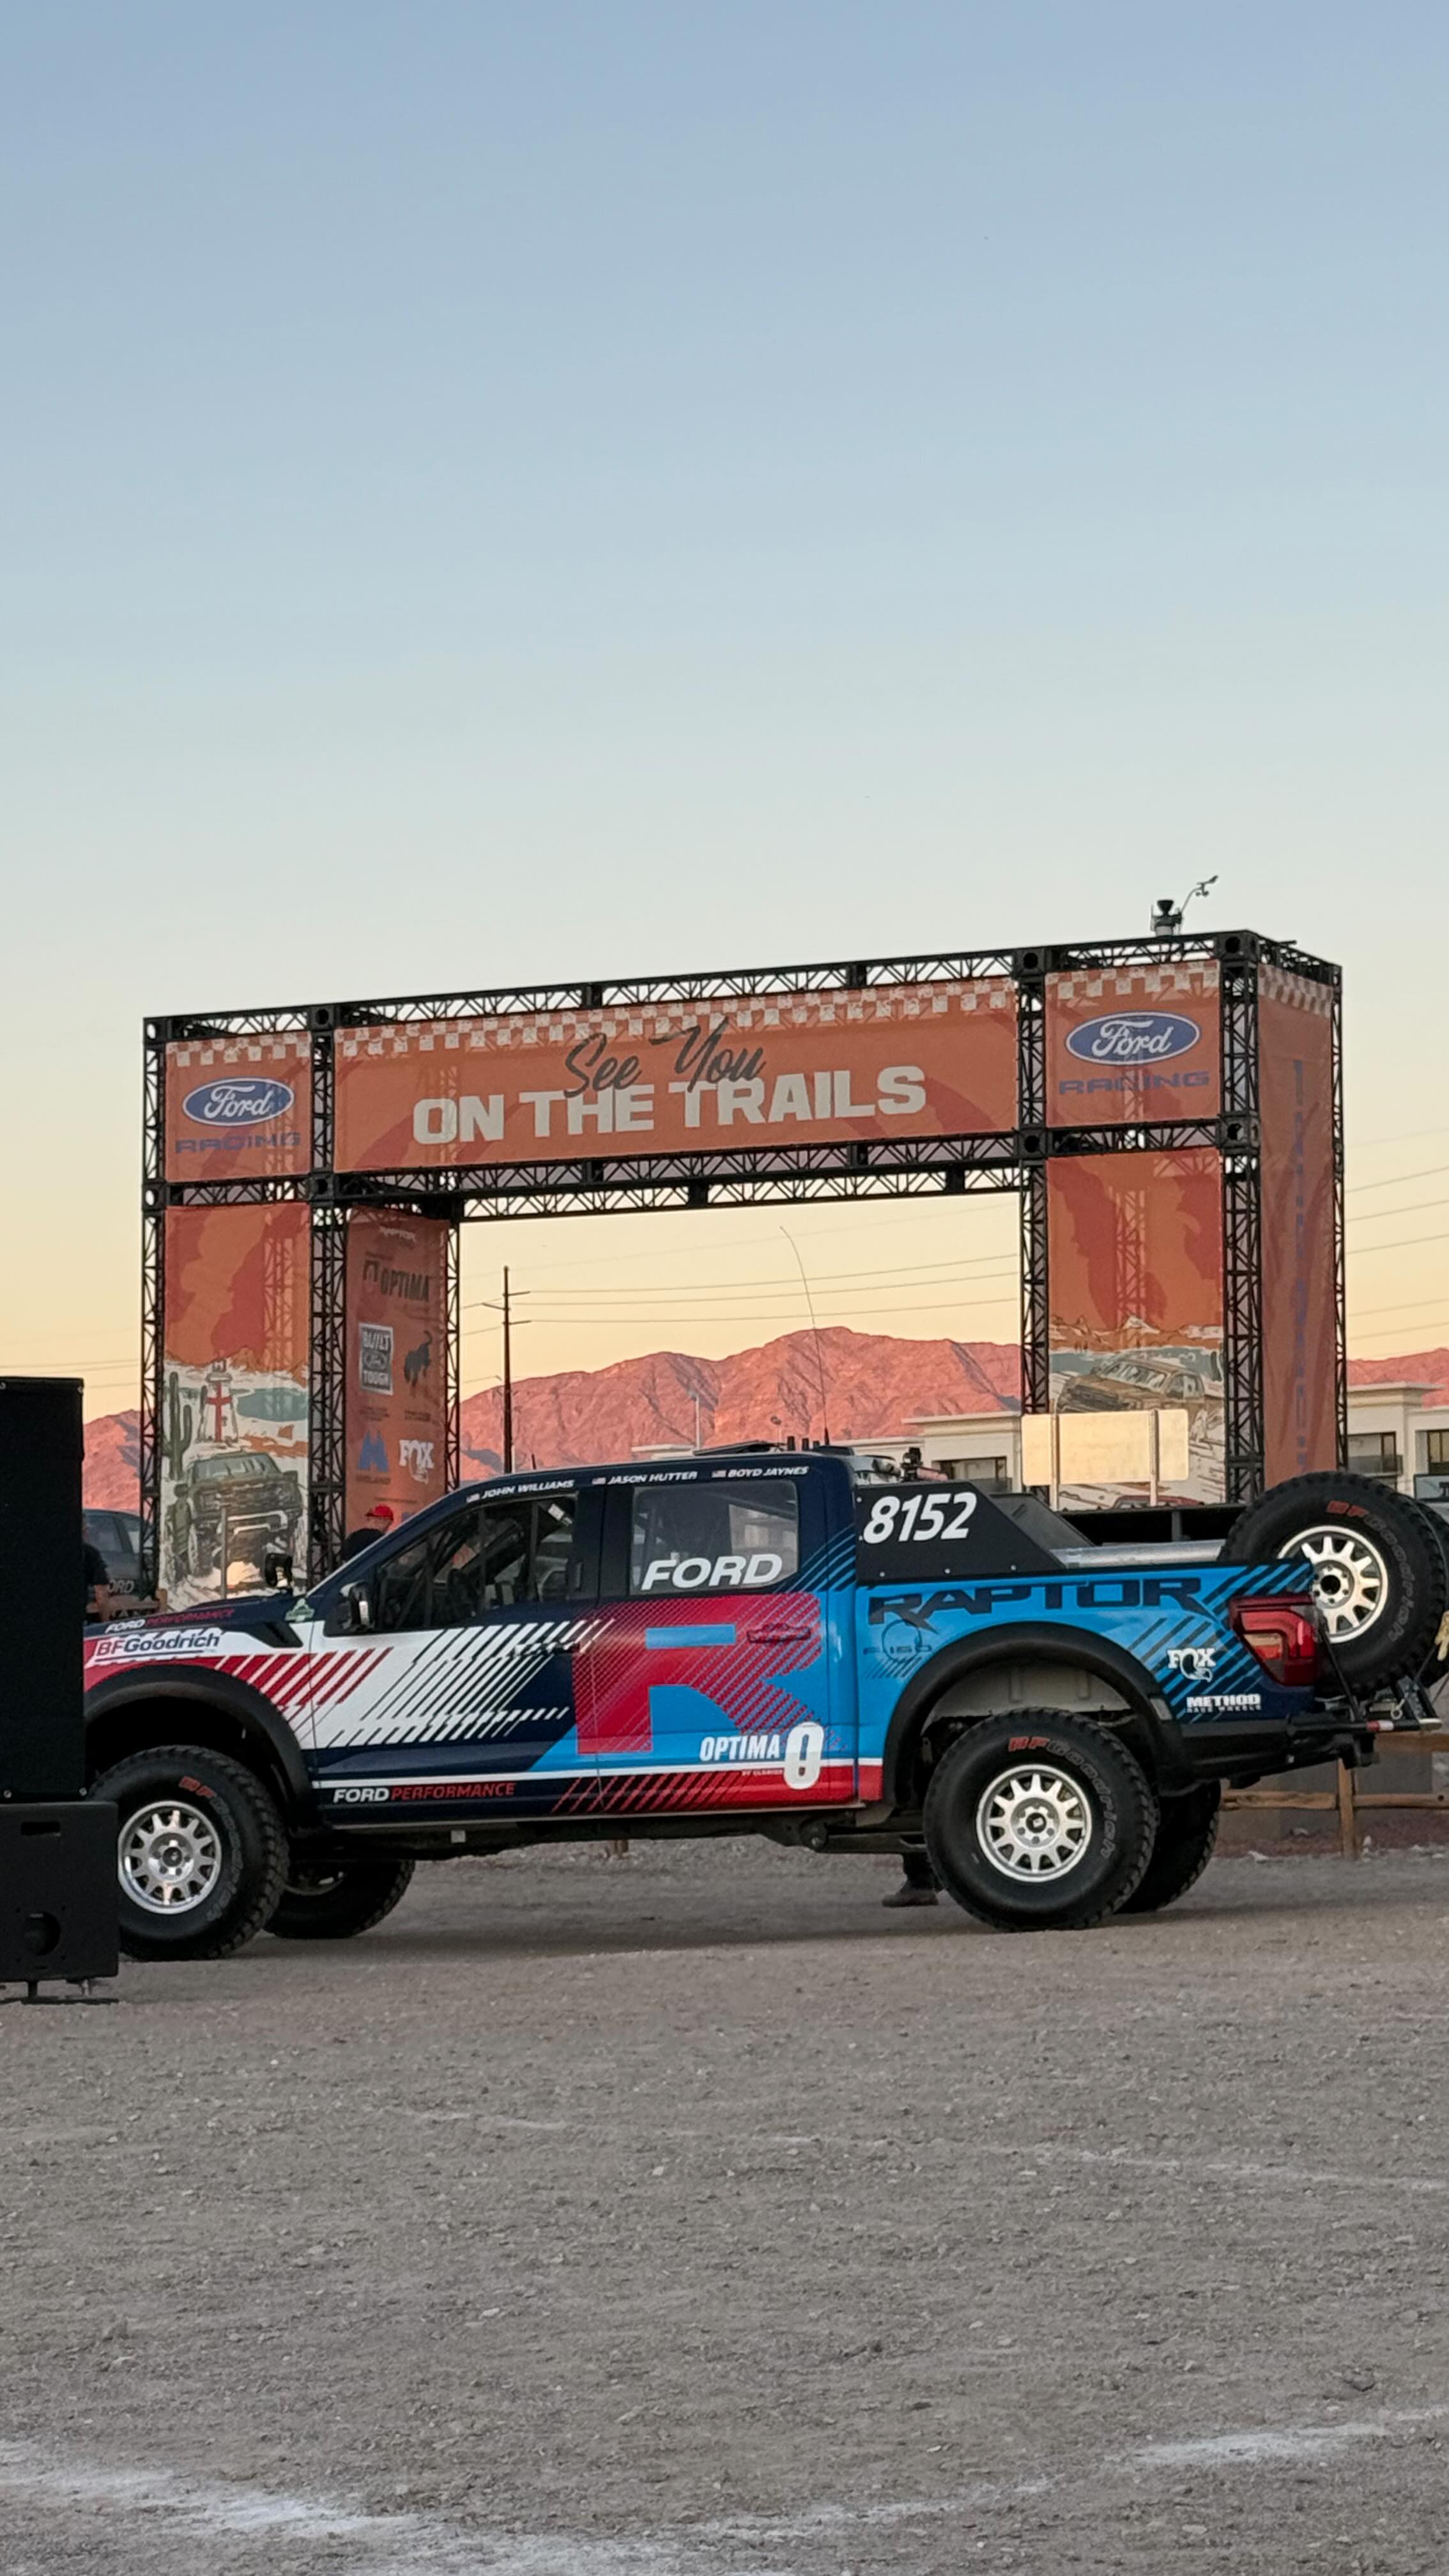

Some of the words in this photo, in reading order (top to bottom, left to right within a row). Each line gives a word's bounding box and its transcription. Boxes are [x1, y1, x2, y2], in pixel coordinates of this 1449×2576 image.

[564, 1033, 643, 1098] See
[649, 1017, 767, 1093] You
[1059, 1071, 1209, 1094] RACING
[413, 1094, 504, 1144] ON
[519, 1085, 654, 1137] THE
[668, 1065, 926, 1128] TRAILS
[176, 1131, 300, 1154] RACING
[381, 1268, 429, 1302] OPTIMA
[362, 1331, 390, 1351] BUILT
[363, 1370, 389, 1386] TOUGH
[399, 1439, 434, 1484] FOX
[728, 1468, 761, 1478] BOYD
[763, 1466, 809, 1476] JAYNES
[482, 1486, 514, 1499] JOHN
[518, 1480, 574, 1492] WILLIAMS
[608, 1475, 647, 1485] JASON
[649, 1471, 698, 1482] HUTTER
[863, 1492, 977, 1544] 8152
[641, 1553, 783, 1590] FORD
[107, 1578, 134, 1593] ORD
[868, 1577, 1223, 1634] RAPTOR
[105, 1619, 145, 1634] FORD
[146, 1609, 235, 1626] PERFORMANCE
[96, 1632, 220, 1656] BFGoodrich
[1167, 1648, 1216, 1683] FOX
[1186, 1694, 1261, 1707] METHOD
[700, 1734, 780, 1761] OPTIMA
[333, 1788, 390, 1804] FORD
[391, 1782, 516, 1800] PERFORMANCE
